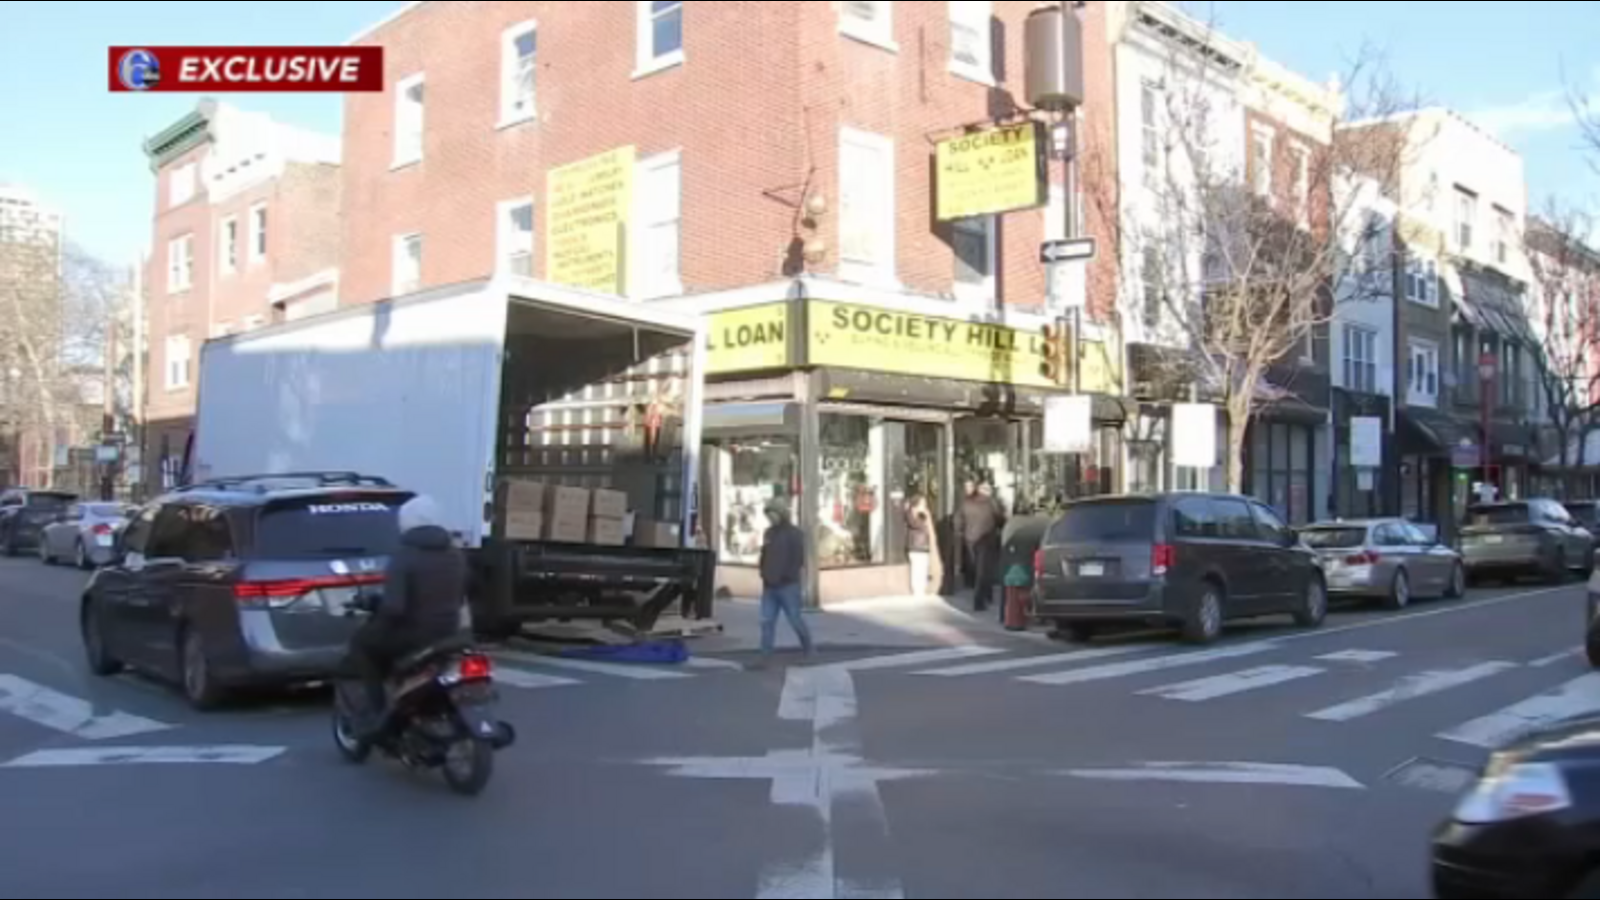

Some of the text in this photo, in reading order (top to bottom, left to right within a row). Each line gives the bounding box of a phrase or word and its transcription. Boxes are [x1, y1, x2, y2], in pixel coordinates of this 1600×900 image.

[949, 126, 1022, 155] SOCIETY
[724, 319, 784, 350] LOAN
[832, 307, 957, 342] SOCIETY
[966, 322, 1018, 352] HILL
[308, 502, 390, 514] HONDA
